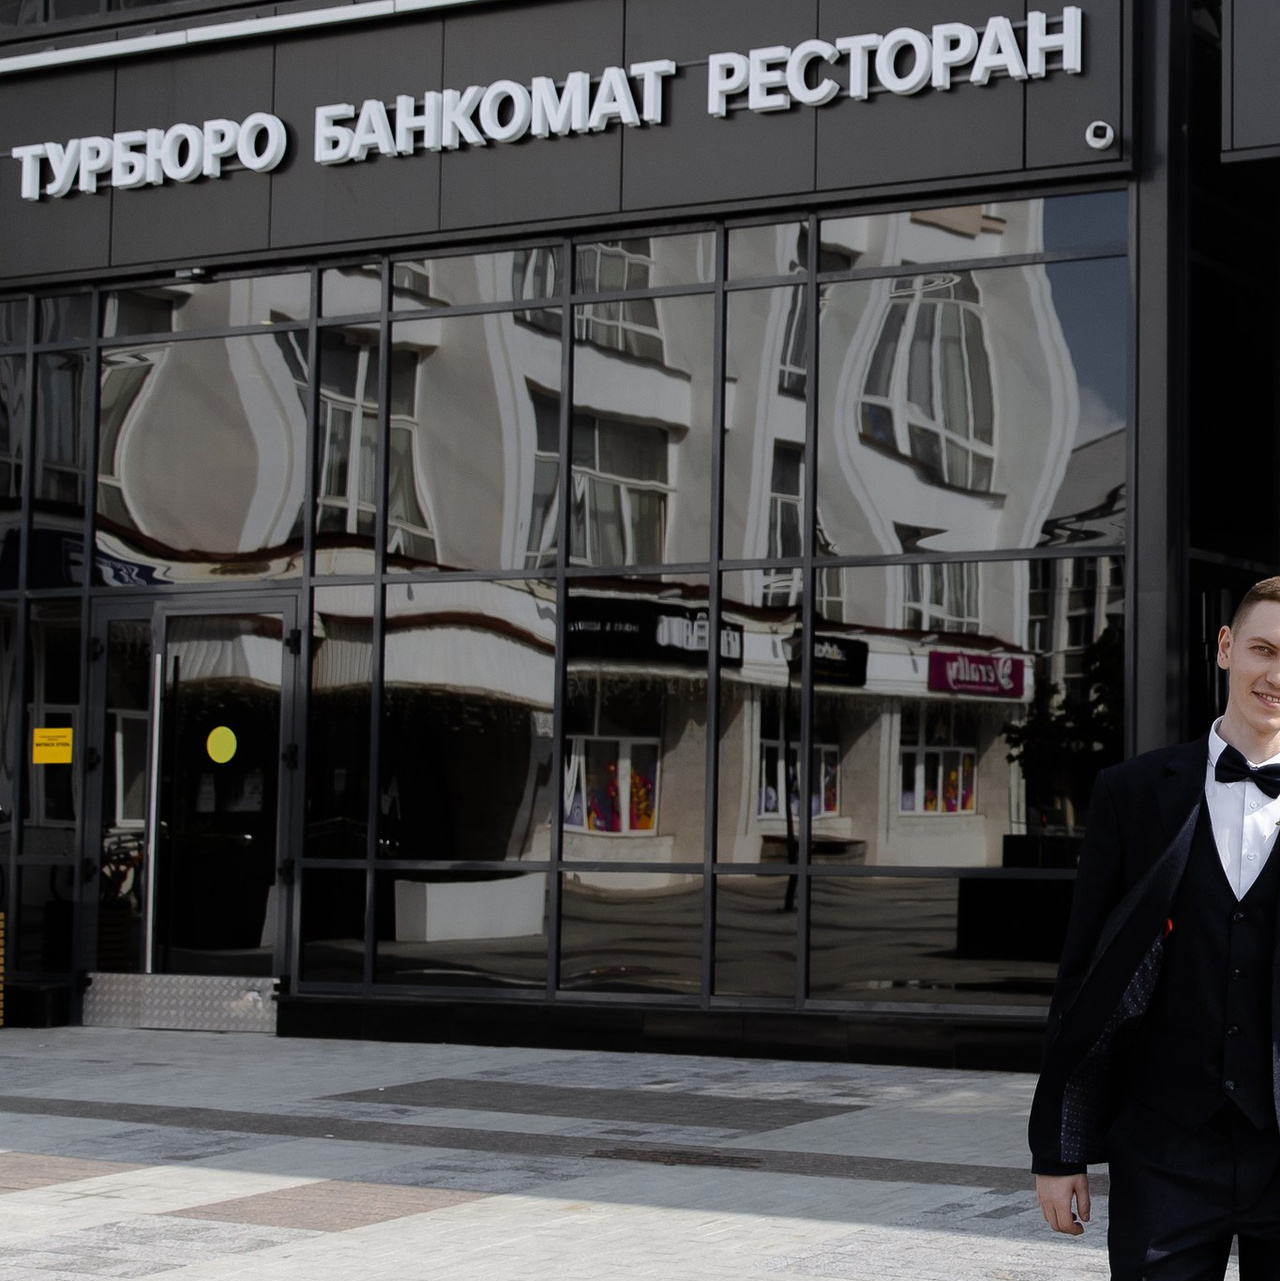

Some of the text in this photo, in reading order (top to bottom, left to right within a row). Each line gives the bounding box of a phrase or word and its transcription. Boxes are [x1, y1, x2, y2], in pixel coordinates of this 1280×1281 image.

[12, 5, 1082, 200] ТУРБЮРО БАНКОМАТ РЕСТОРАН
